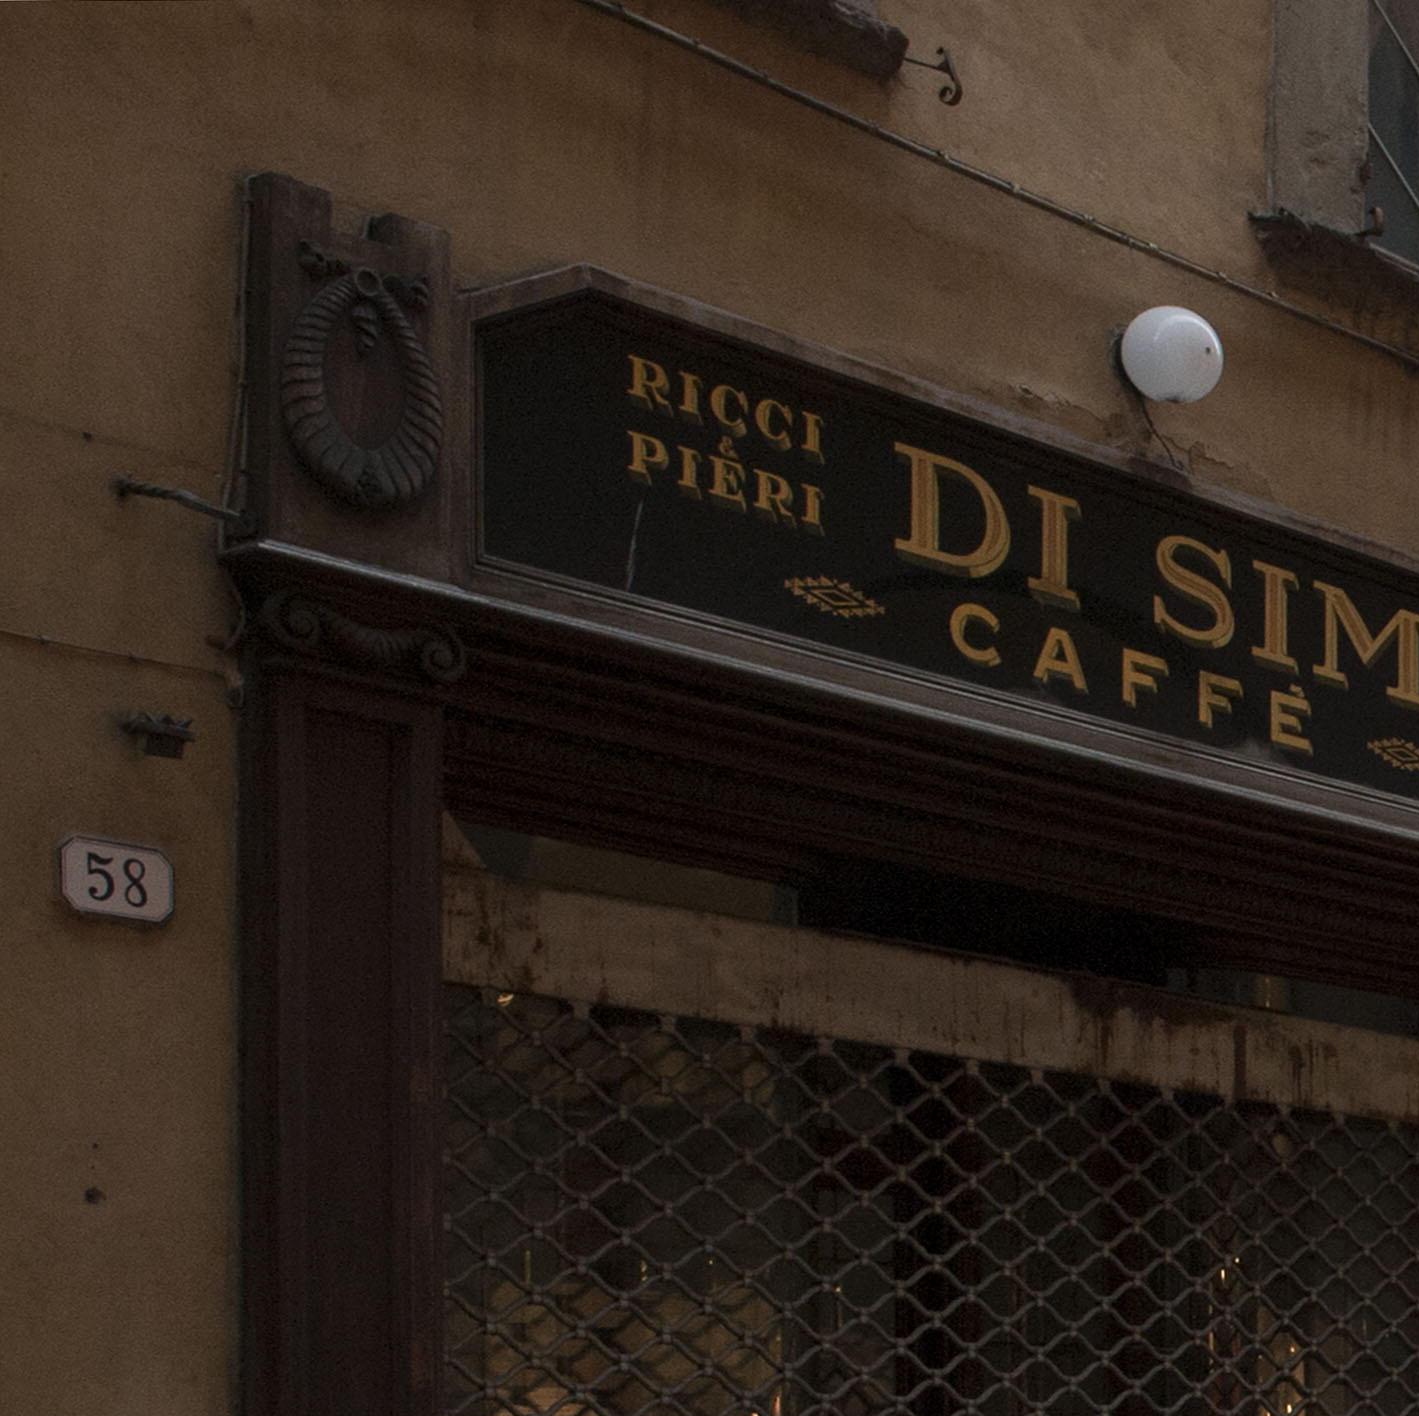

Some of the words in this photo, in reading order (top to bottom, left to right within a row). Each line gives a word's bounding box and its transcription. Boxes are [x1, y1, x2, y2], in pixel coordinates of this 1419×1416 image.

[626, 354, 825, 464] RICCI
[626, 430, 825, 536] PIERI
[894, 441, 1083, 612] DI
[948, 602, 1315, 757] CAFFÈ
[84, 851, 150, 909] 58
